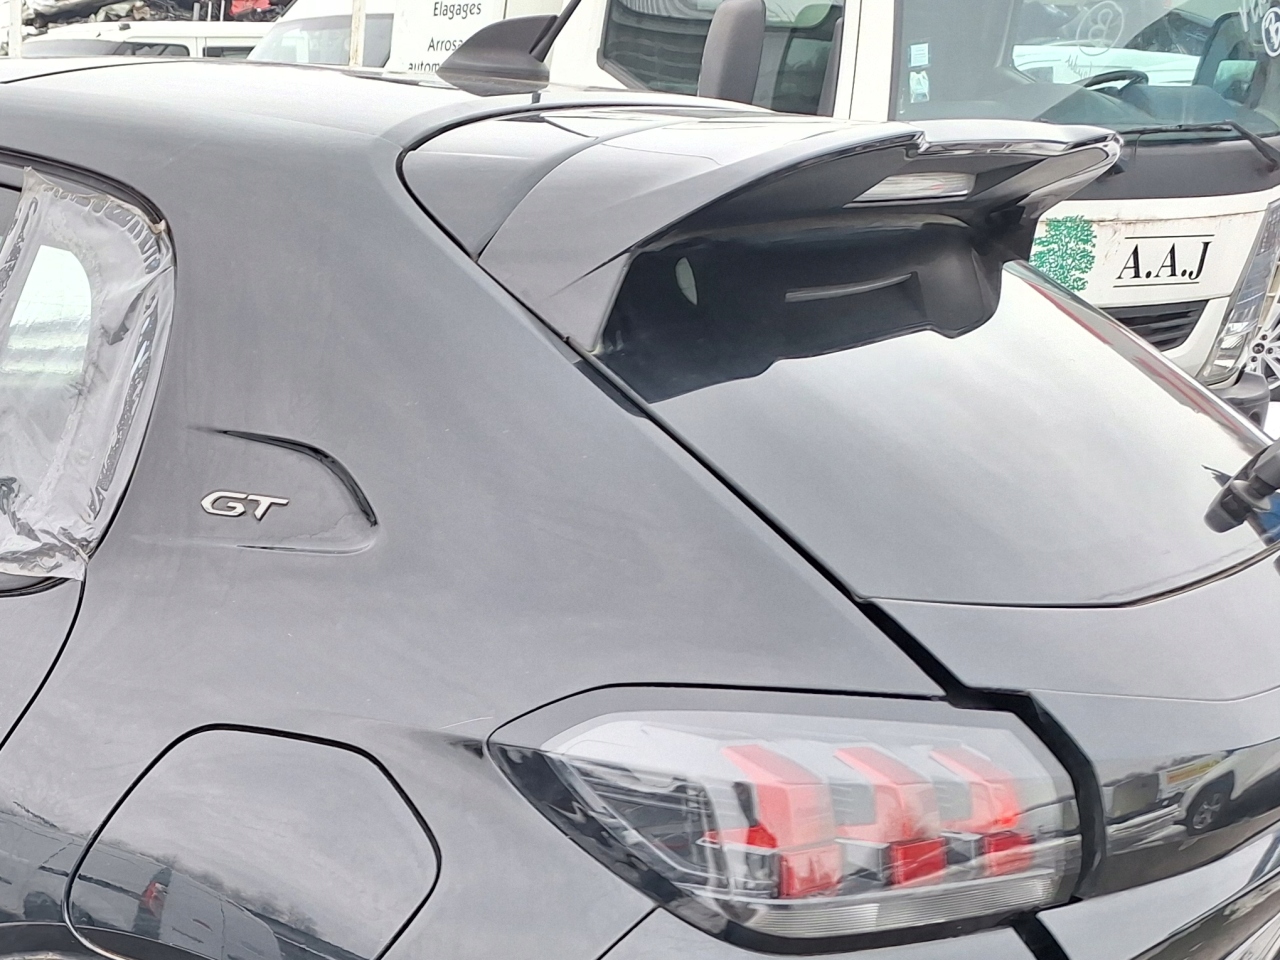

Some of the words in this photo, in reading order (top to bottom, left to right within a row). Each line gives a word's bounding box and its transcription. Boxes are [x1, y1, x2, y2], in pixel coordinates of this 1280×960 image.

[433, 1, 482, 20] Elagages
[1115, 241, 1213, 280] A.A.J
[201, 490, 289, 521] GT
